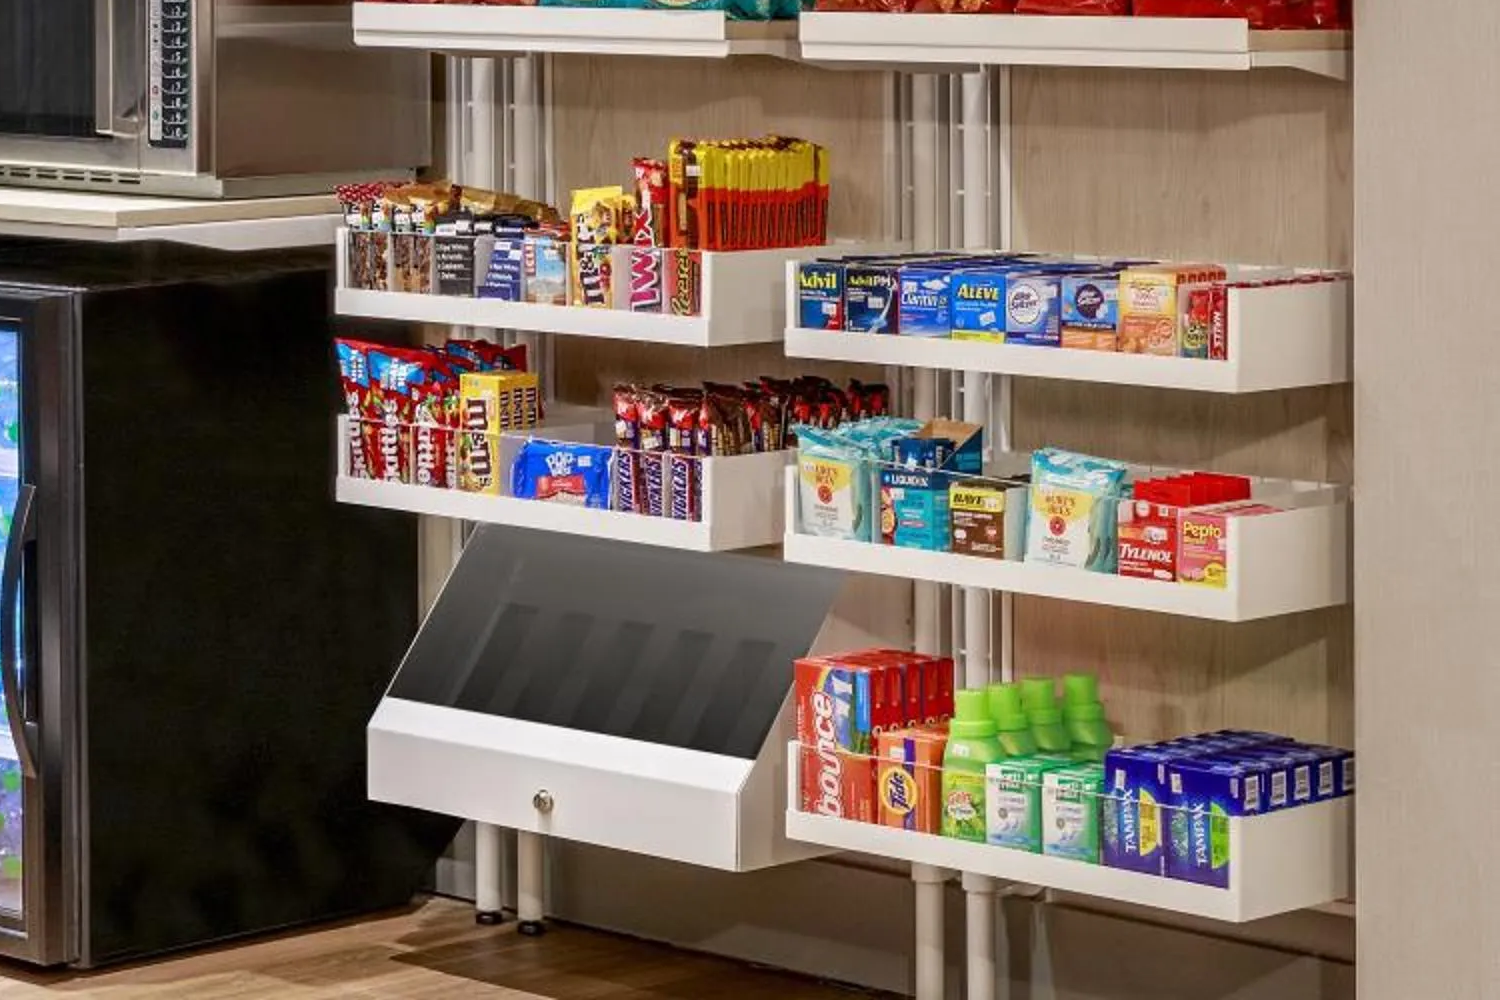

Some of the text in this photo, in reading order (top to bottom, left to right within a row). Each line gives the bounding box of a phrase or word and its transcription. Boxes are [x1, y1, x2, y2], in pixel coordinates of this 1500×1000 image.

[799, 271, 837, 289] Advil
[957, 283, 1000, 301] ALEVE
[617, 451, 633, 511] NICKERS
[647, 456, 663, 516] NICKERS
[672, 457, 688, 520] NICKERS
[1182, 519, 1222, 538] Pepto
[1119, 542, 1173, 564] TYLENOL
[811, 690, 842, 817] bounce
[888, 771, 911, 811] Tide
